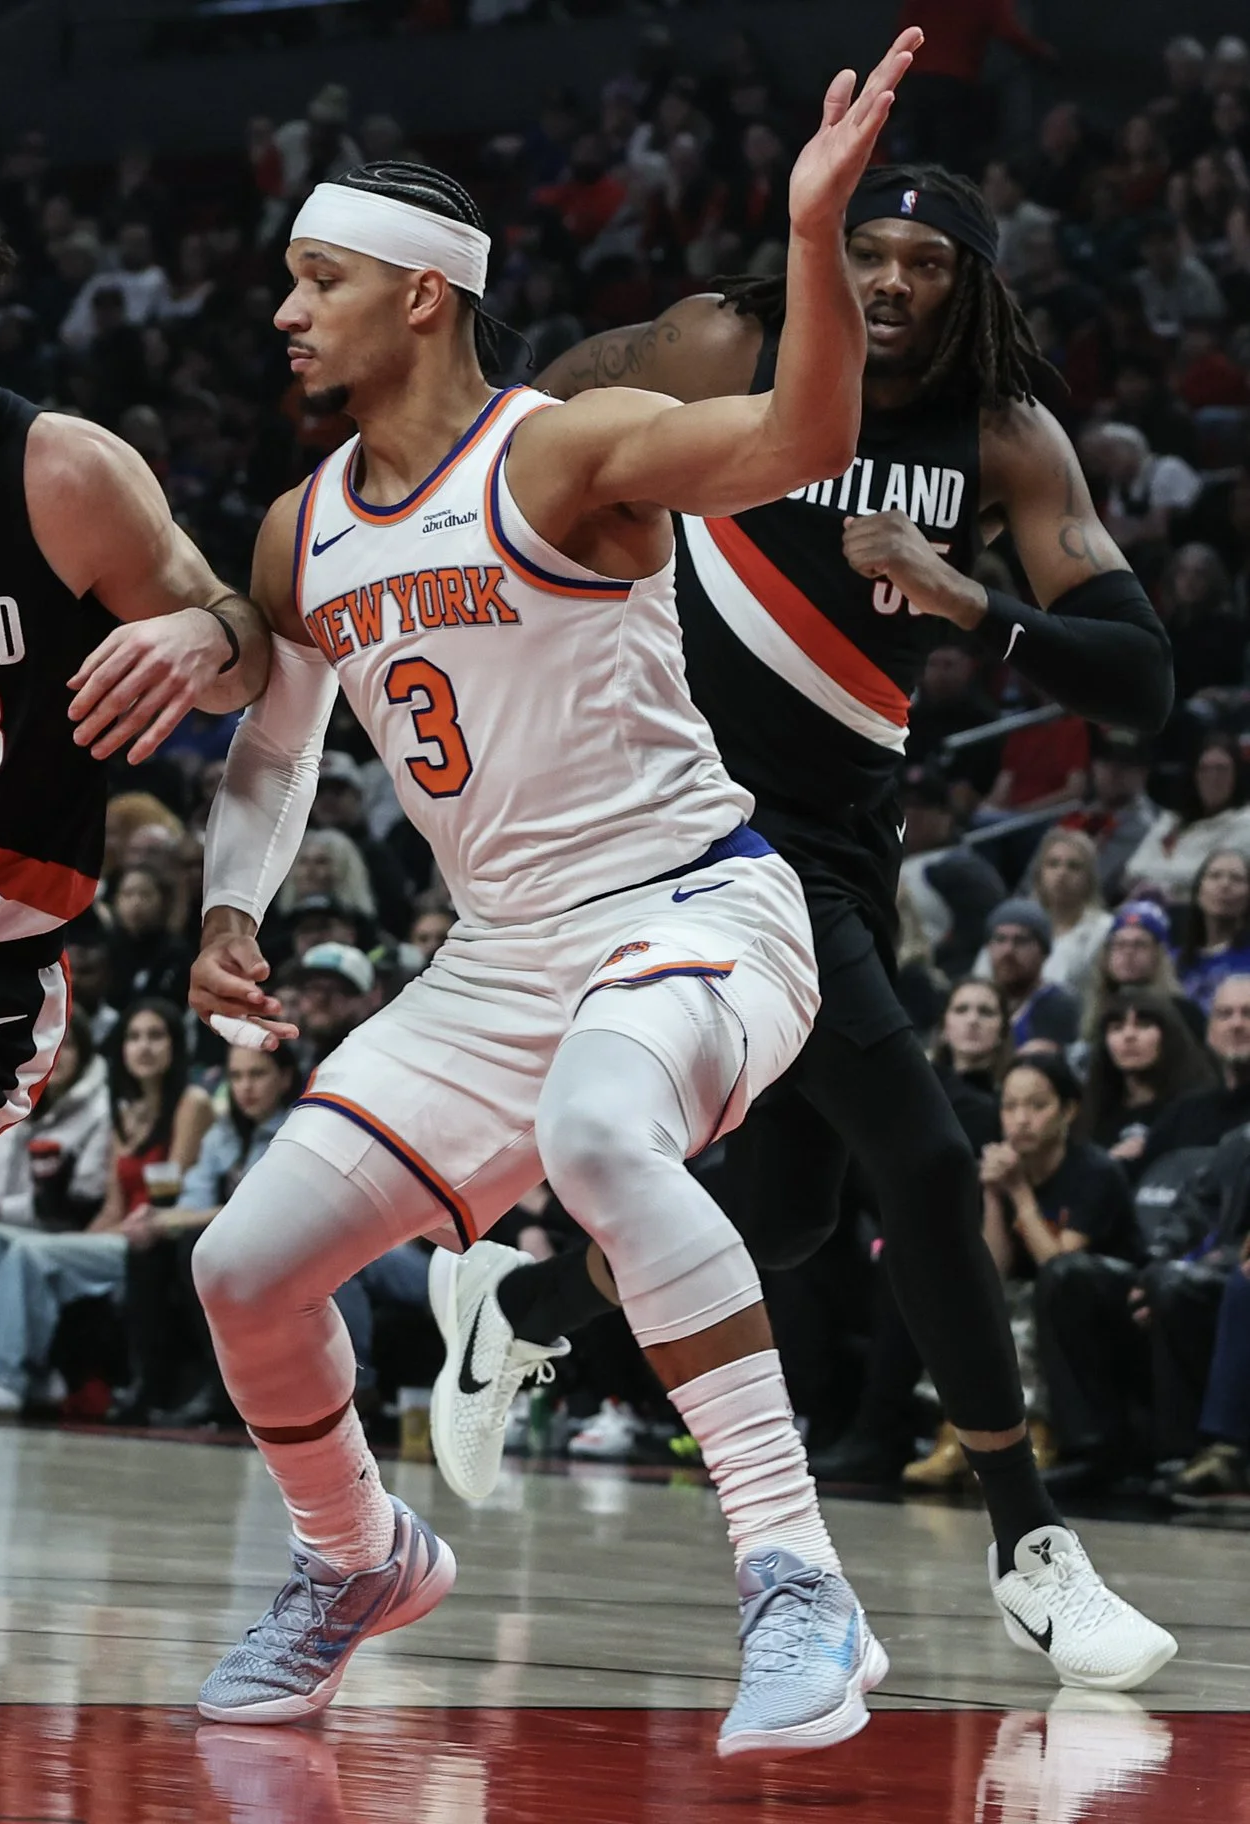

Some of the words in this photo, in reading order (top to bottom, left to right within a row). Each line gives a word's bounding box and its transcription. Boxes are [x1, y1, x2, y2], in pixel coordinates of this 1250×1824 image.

[422, 520, 442, 533] abu
[444, 508, 478, 527] dhabi
[305, 580, 384, 669] NEW
[387, 565, 521, 635] YORK
[384, 656, 473, 799] 3
